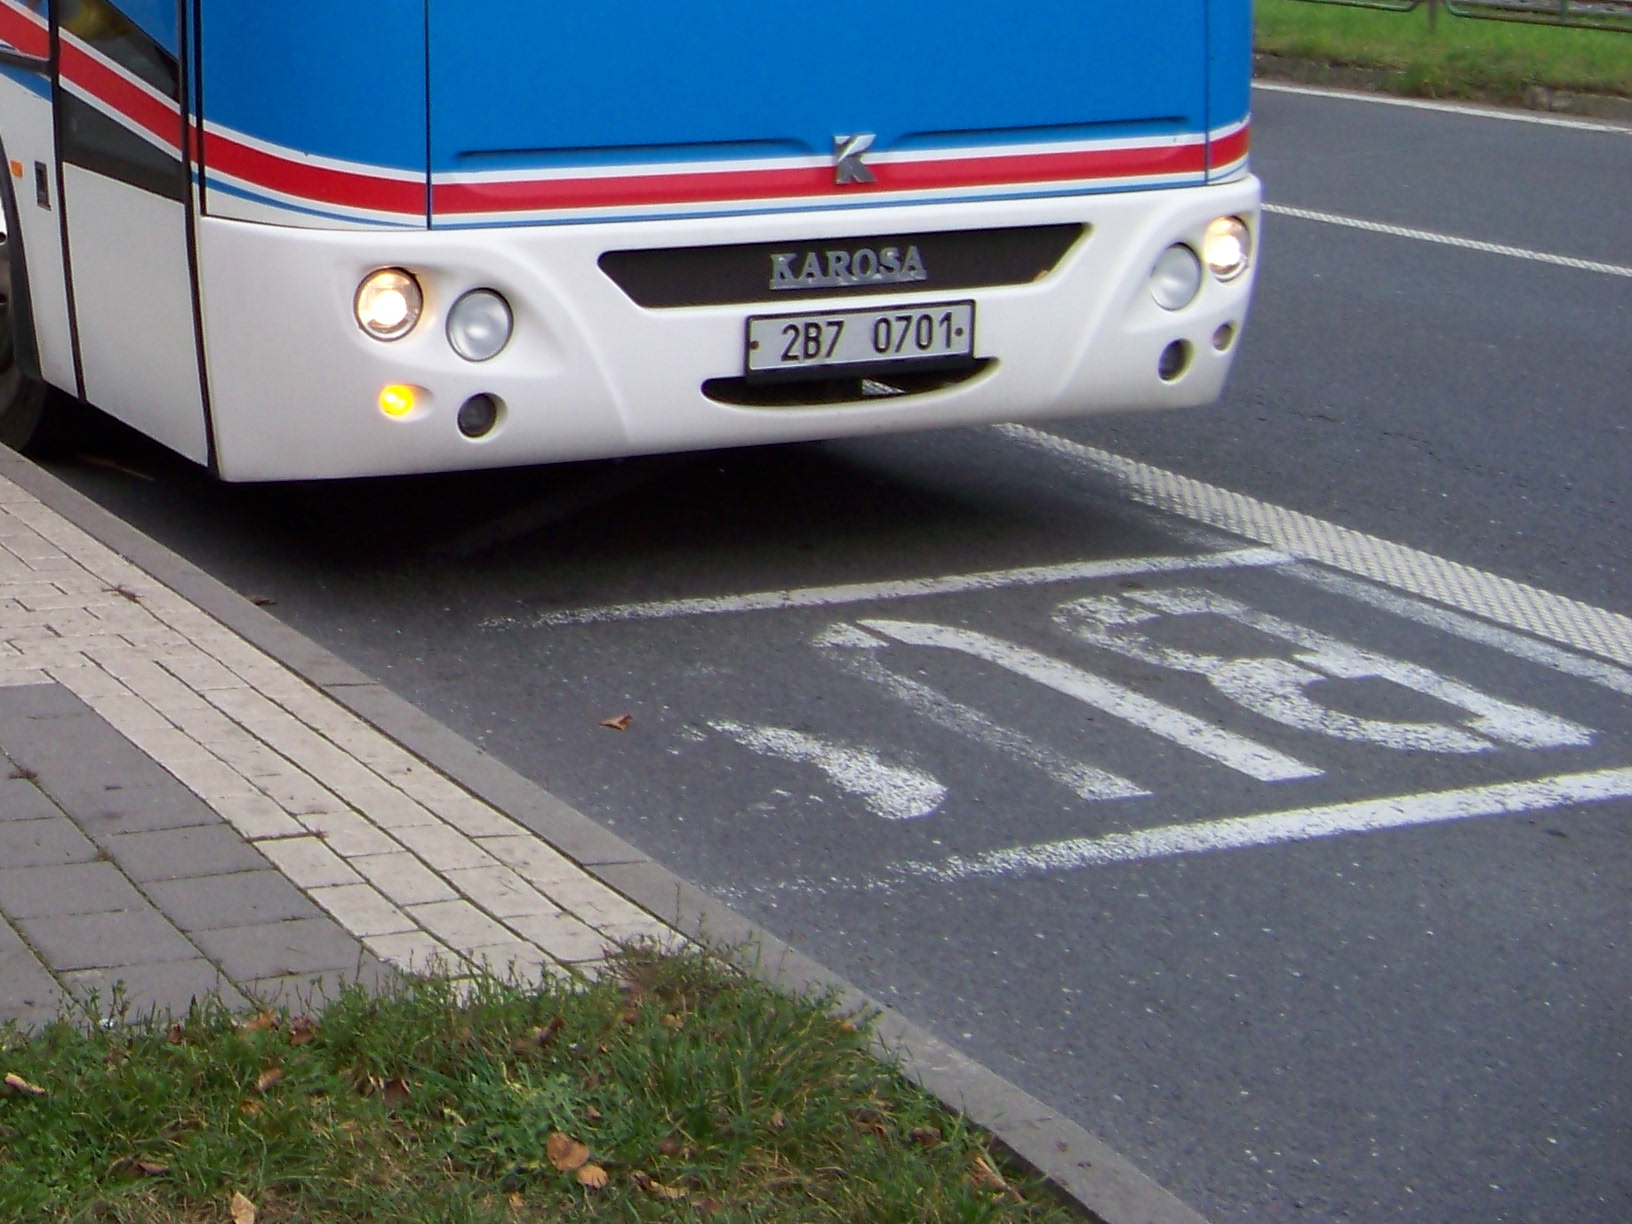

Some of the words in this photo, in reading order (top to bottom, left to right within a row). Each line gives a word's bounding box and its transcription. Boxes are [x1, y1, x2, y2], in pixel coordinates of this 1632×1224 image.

[769, 245, 928, 291] KAROSA
[781, 319, 845, 362] 2B7
[873, 311, 953, 354] 0701
